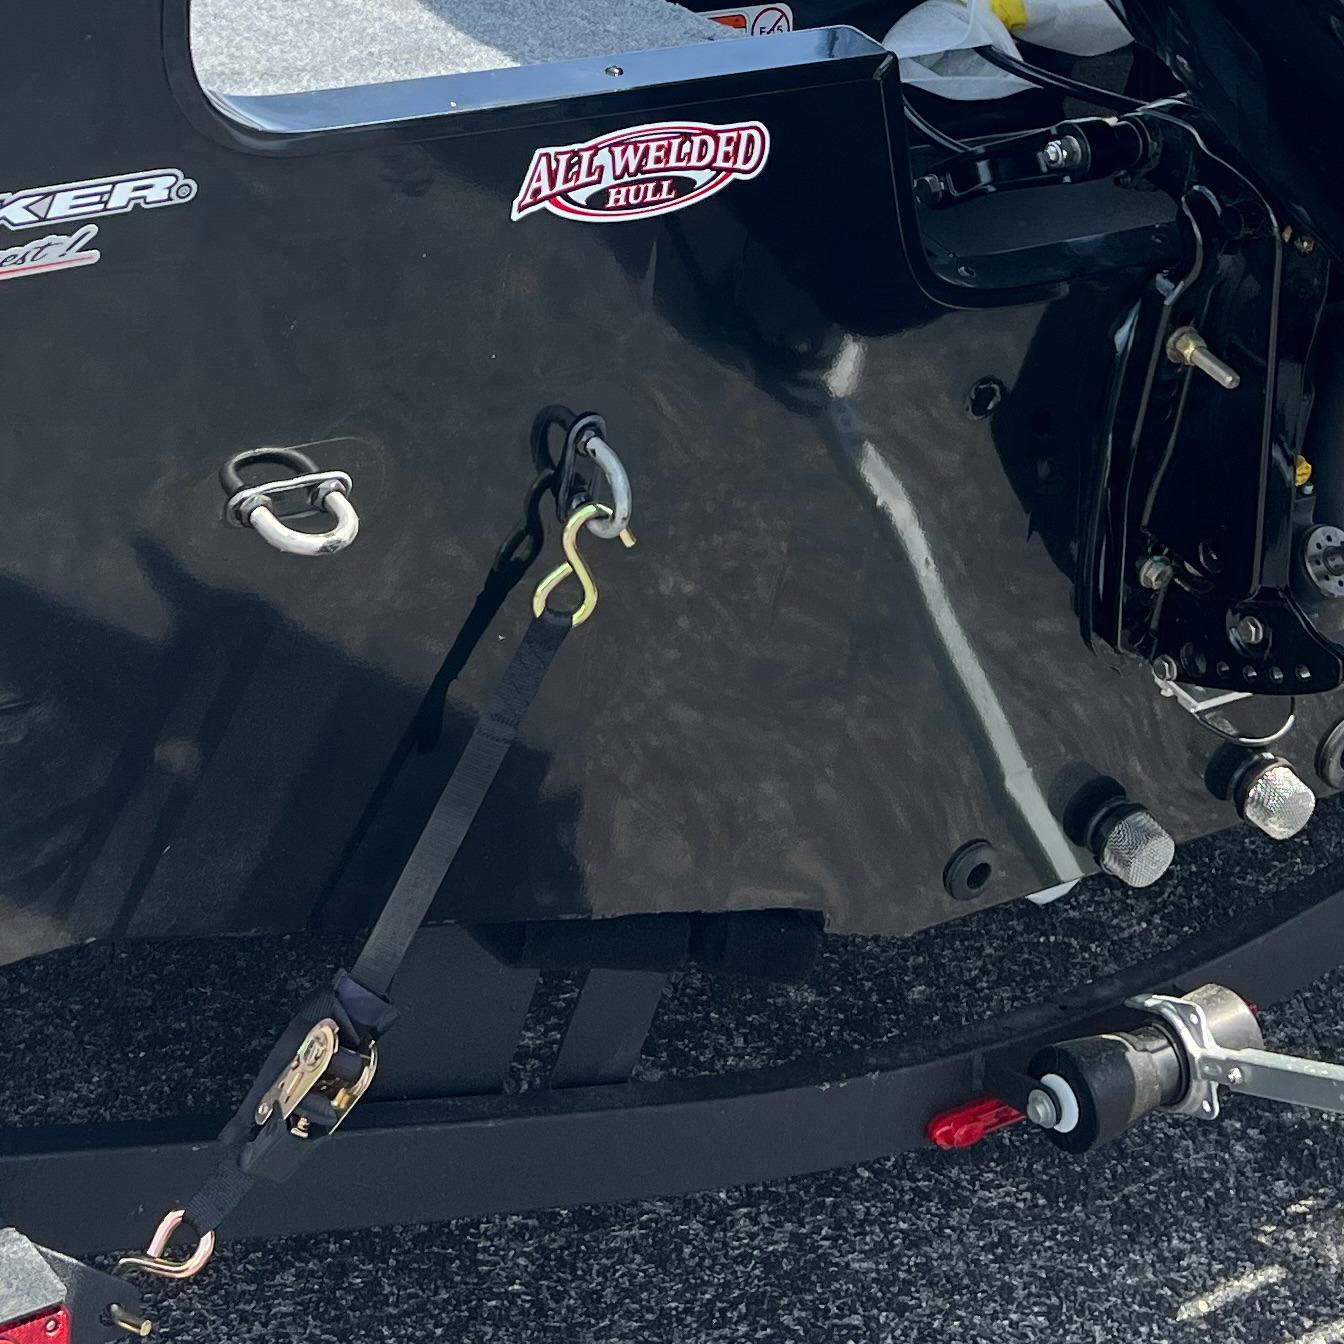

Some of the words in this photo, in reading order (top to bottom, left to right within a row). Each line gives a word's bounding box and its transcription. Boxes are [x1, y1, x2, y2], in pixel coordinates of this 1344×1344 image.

[519, 147, 605, 212] ALL
[609, 129, 763, 177] WELDED
[605, 180, 677, 209] HULL
